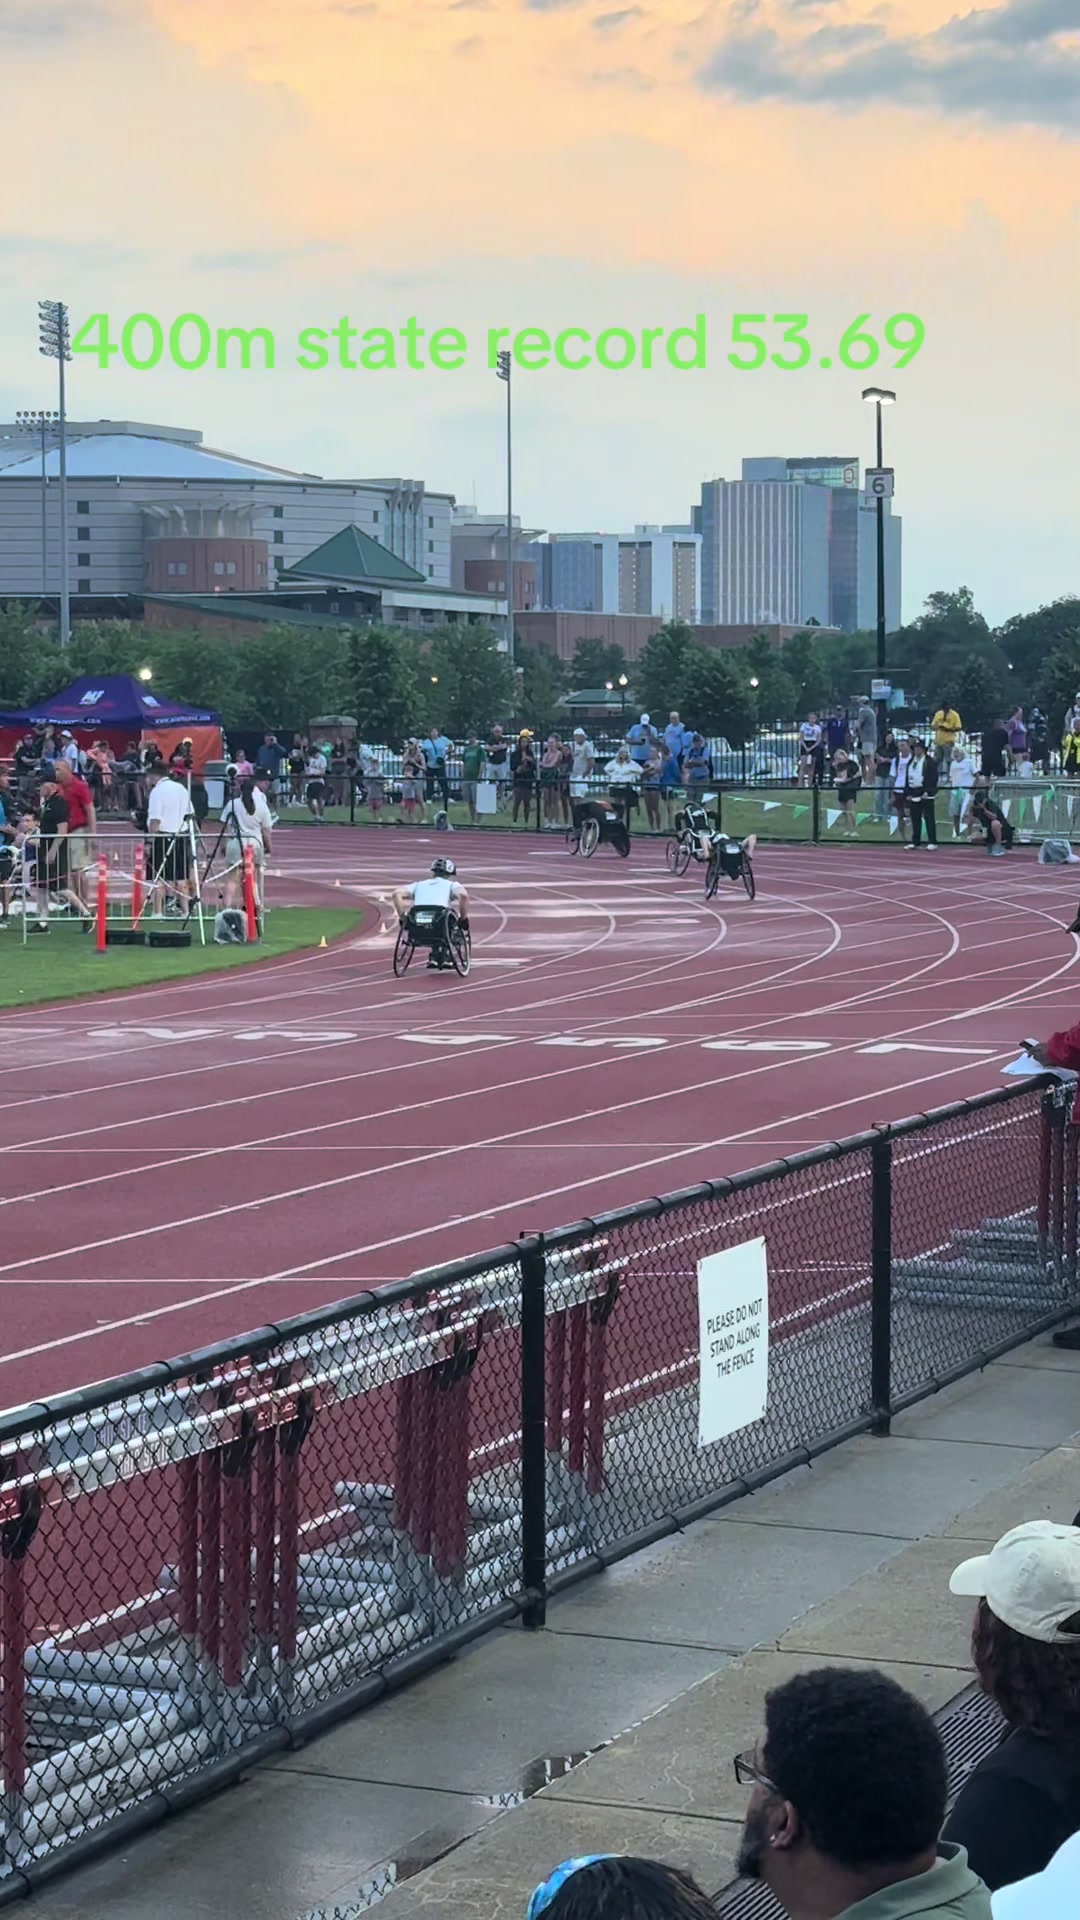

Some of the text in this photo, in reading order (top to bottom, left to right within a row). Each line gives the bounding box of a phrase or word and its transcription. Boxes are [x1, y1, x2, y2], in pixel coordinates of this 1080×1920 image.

[873, 477, 885, 494] 6
[86, 1028, 998, 1054] 2 3 4 5 6 7
[707, 1298, 762, 1335] PLEASE DO NOT
[711, 1322, 760, 1358] STAND ALONG
[717, 1347, 755, 1379] THE FENCE
